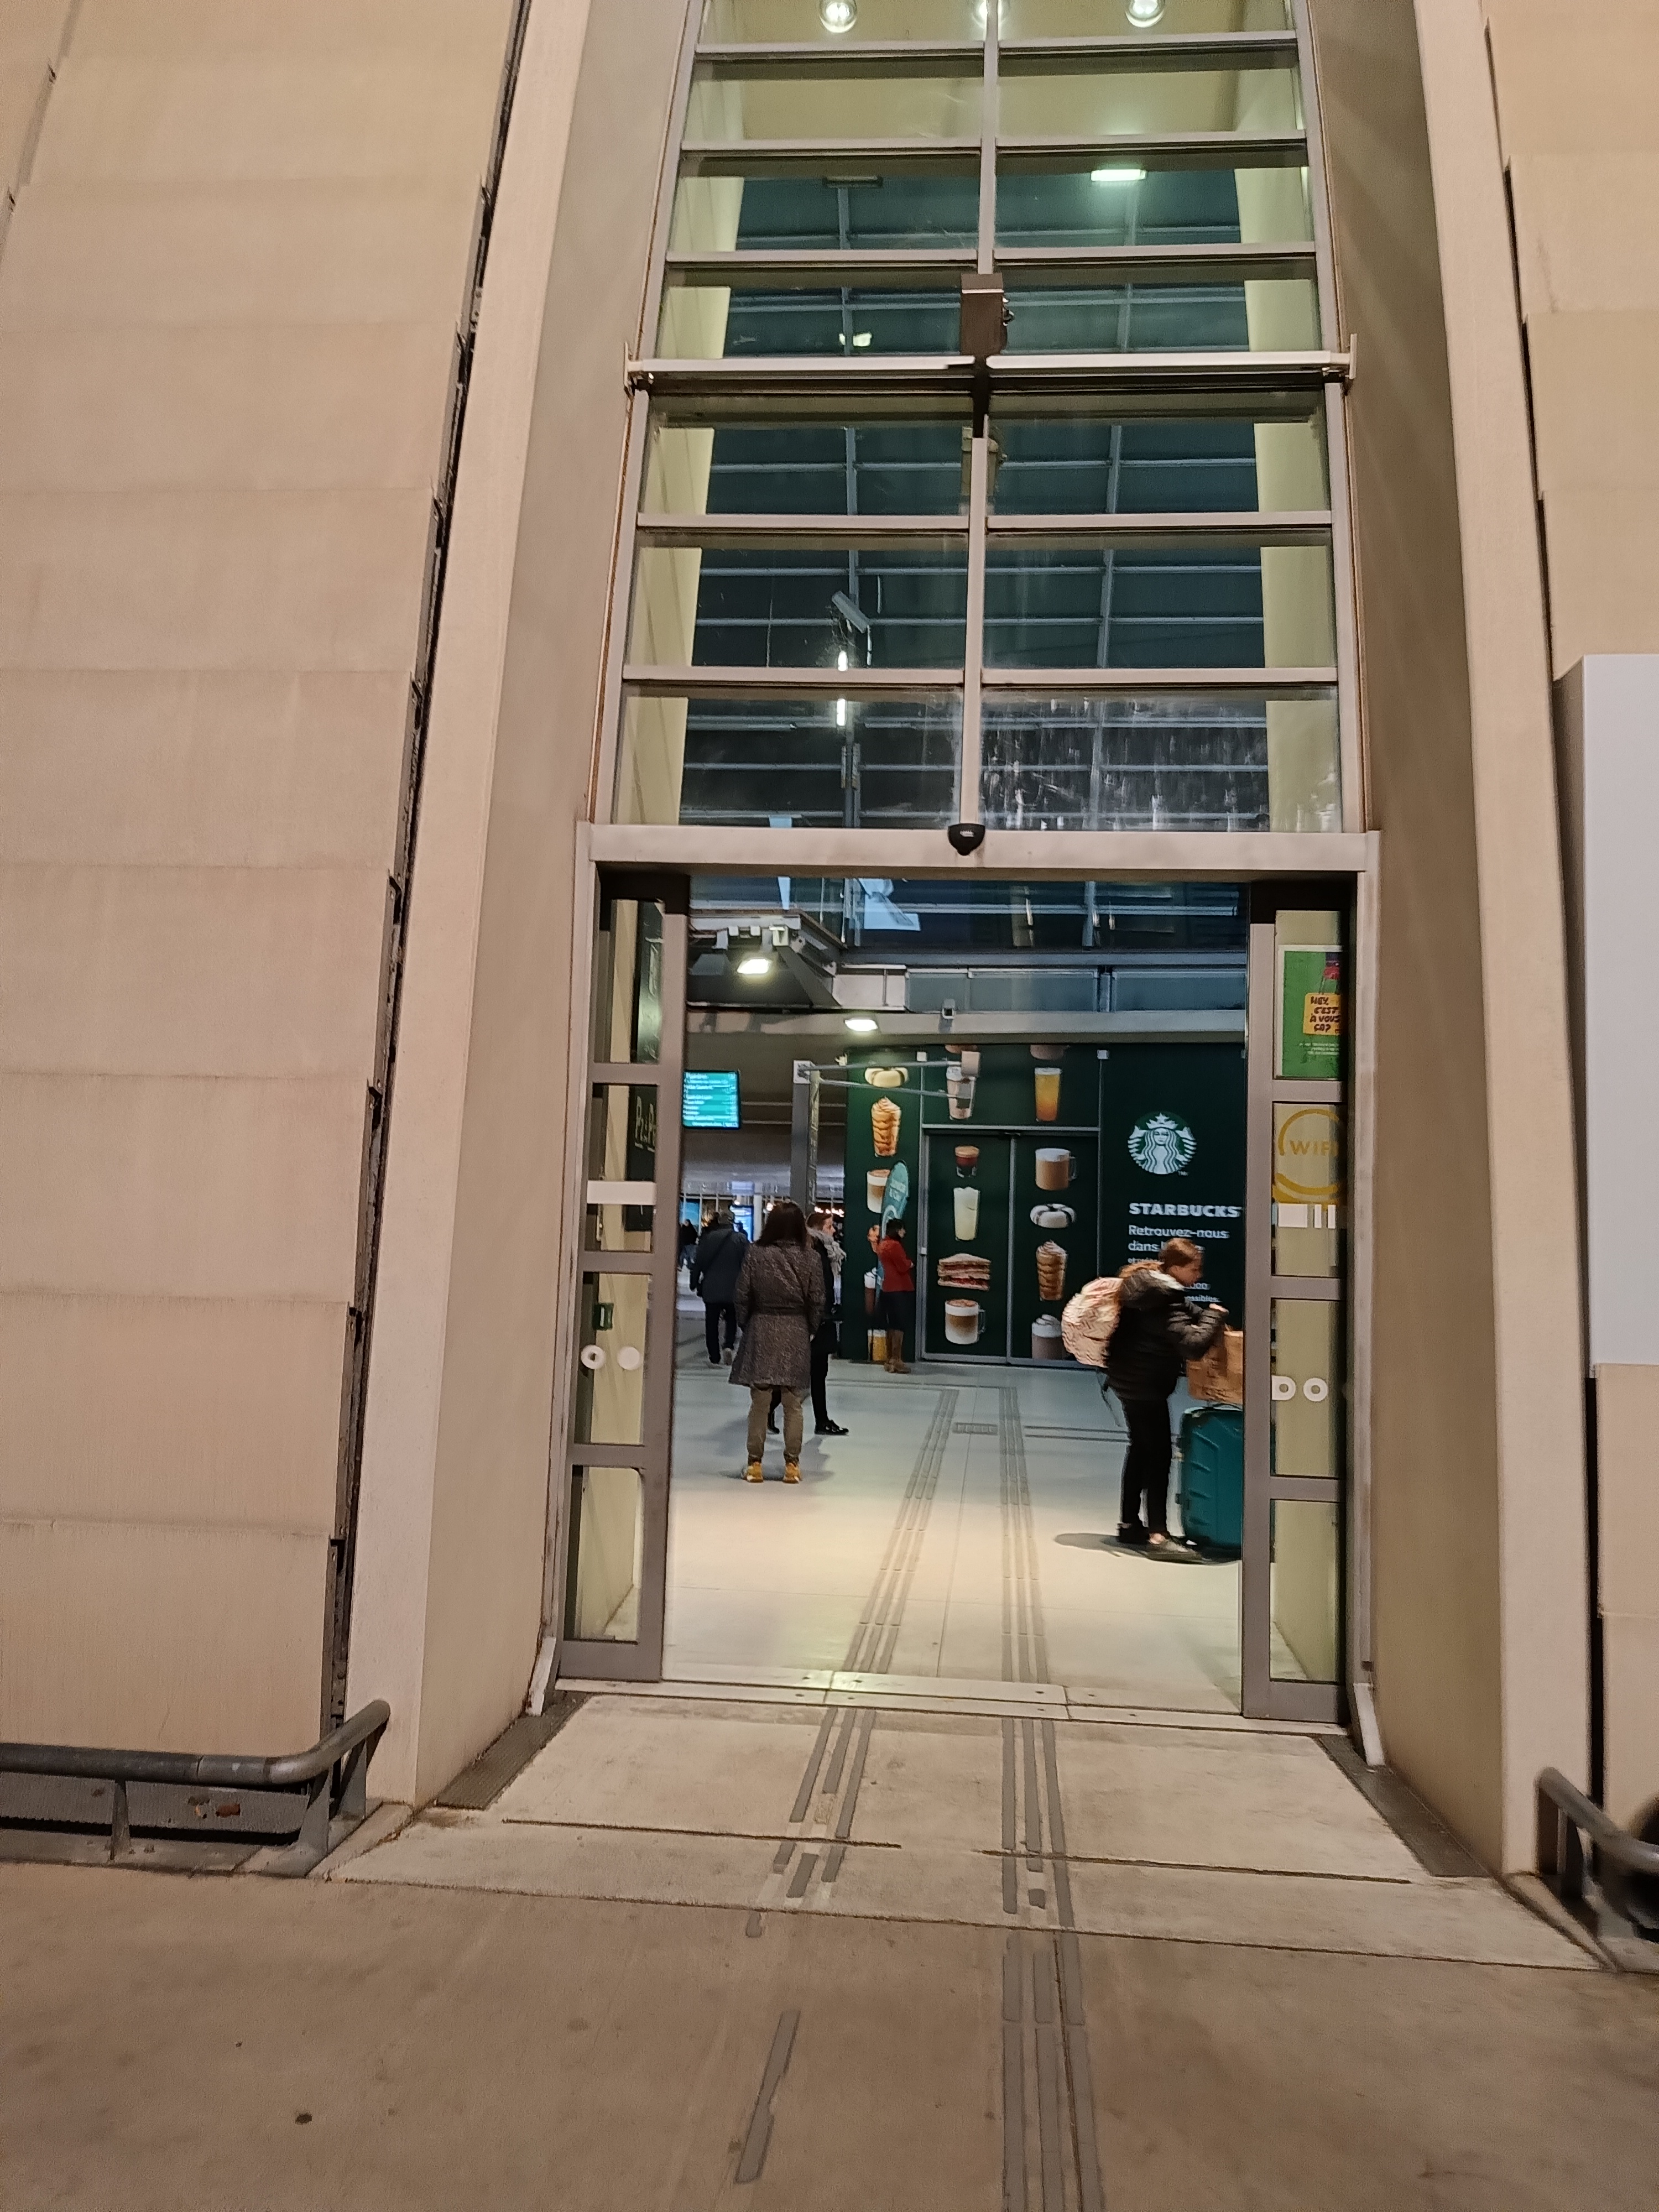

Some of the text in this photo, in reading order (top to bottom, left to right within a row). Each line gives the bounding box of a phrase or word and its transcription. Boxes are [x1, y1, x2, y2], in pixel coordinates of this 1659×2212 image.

[1129, 1203, 1241, 1217] STARBUCKS
[1129, 1225, 1229, 1238] Retrouvez-nous
[1128, 1240, 1160, 1251] dans
